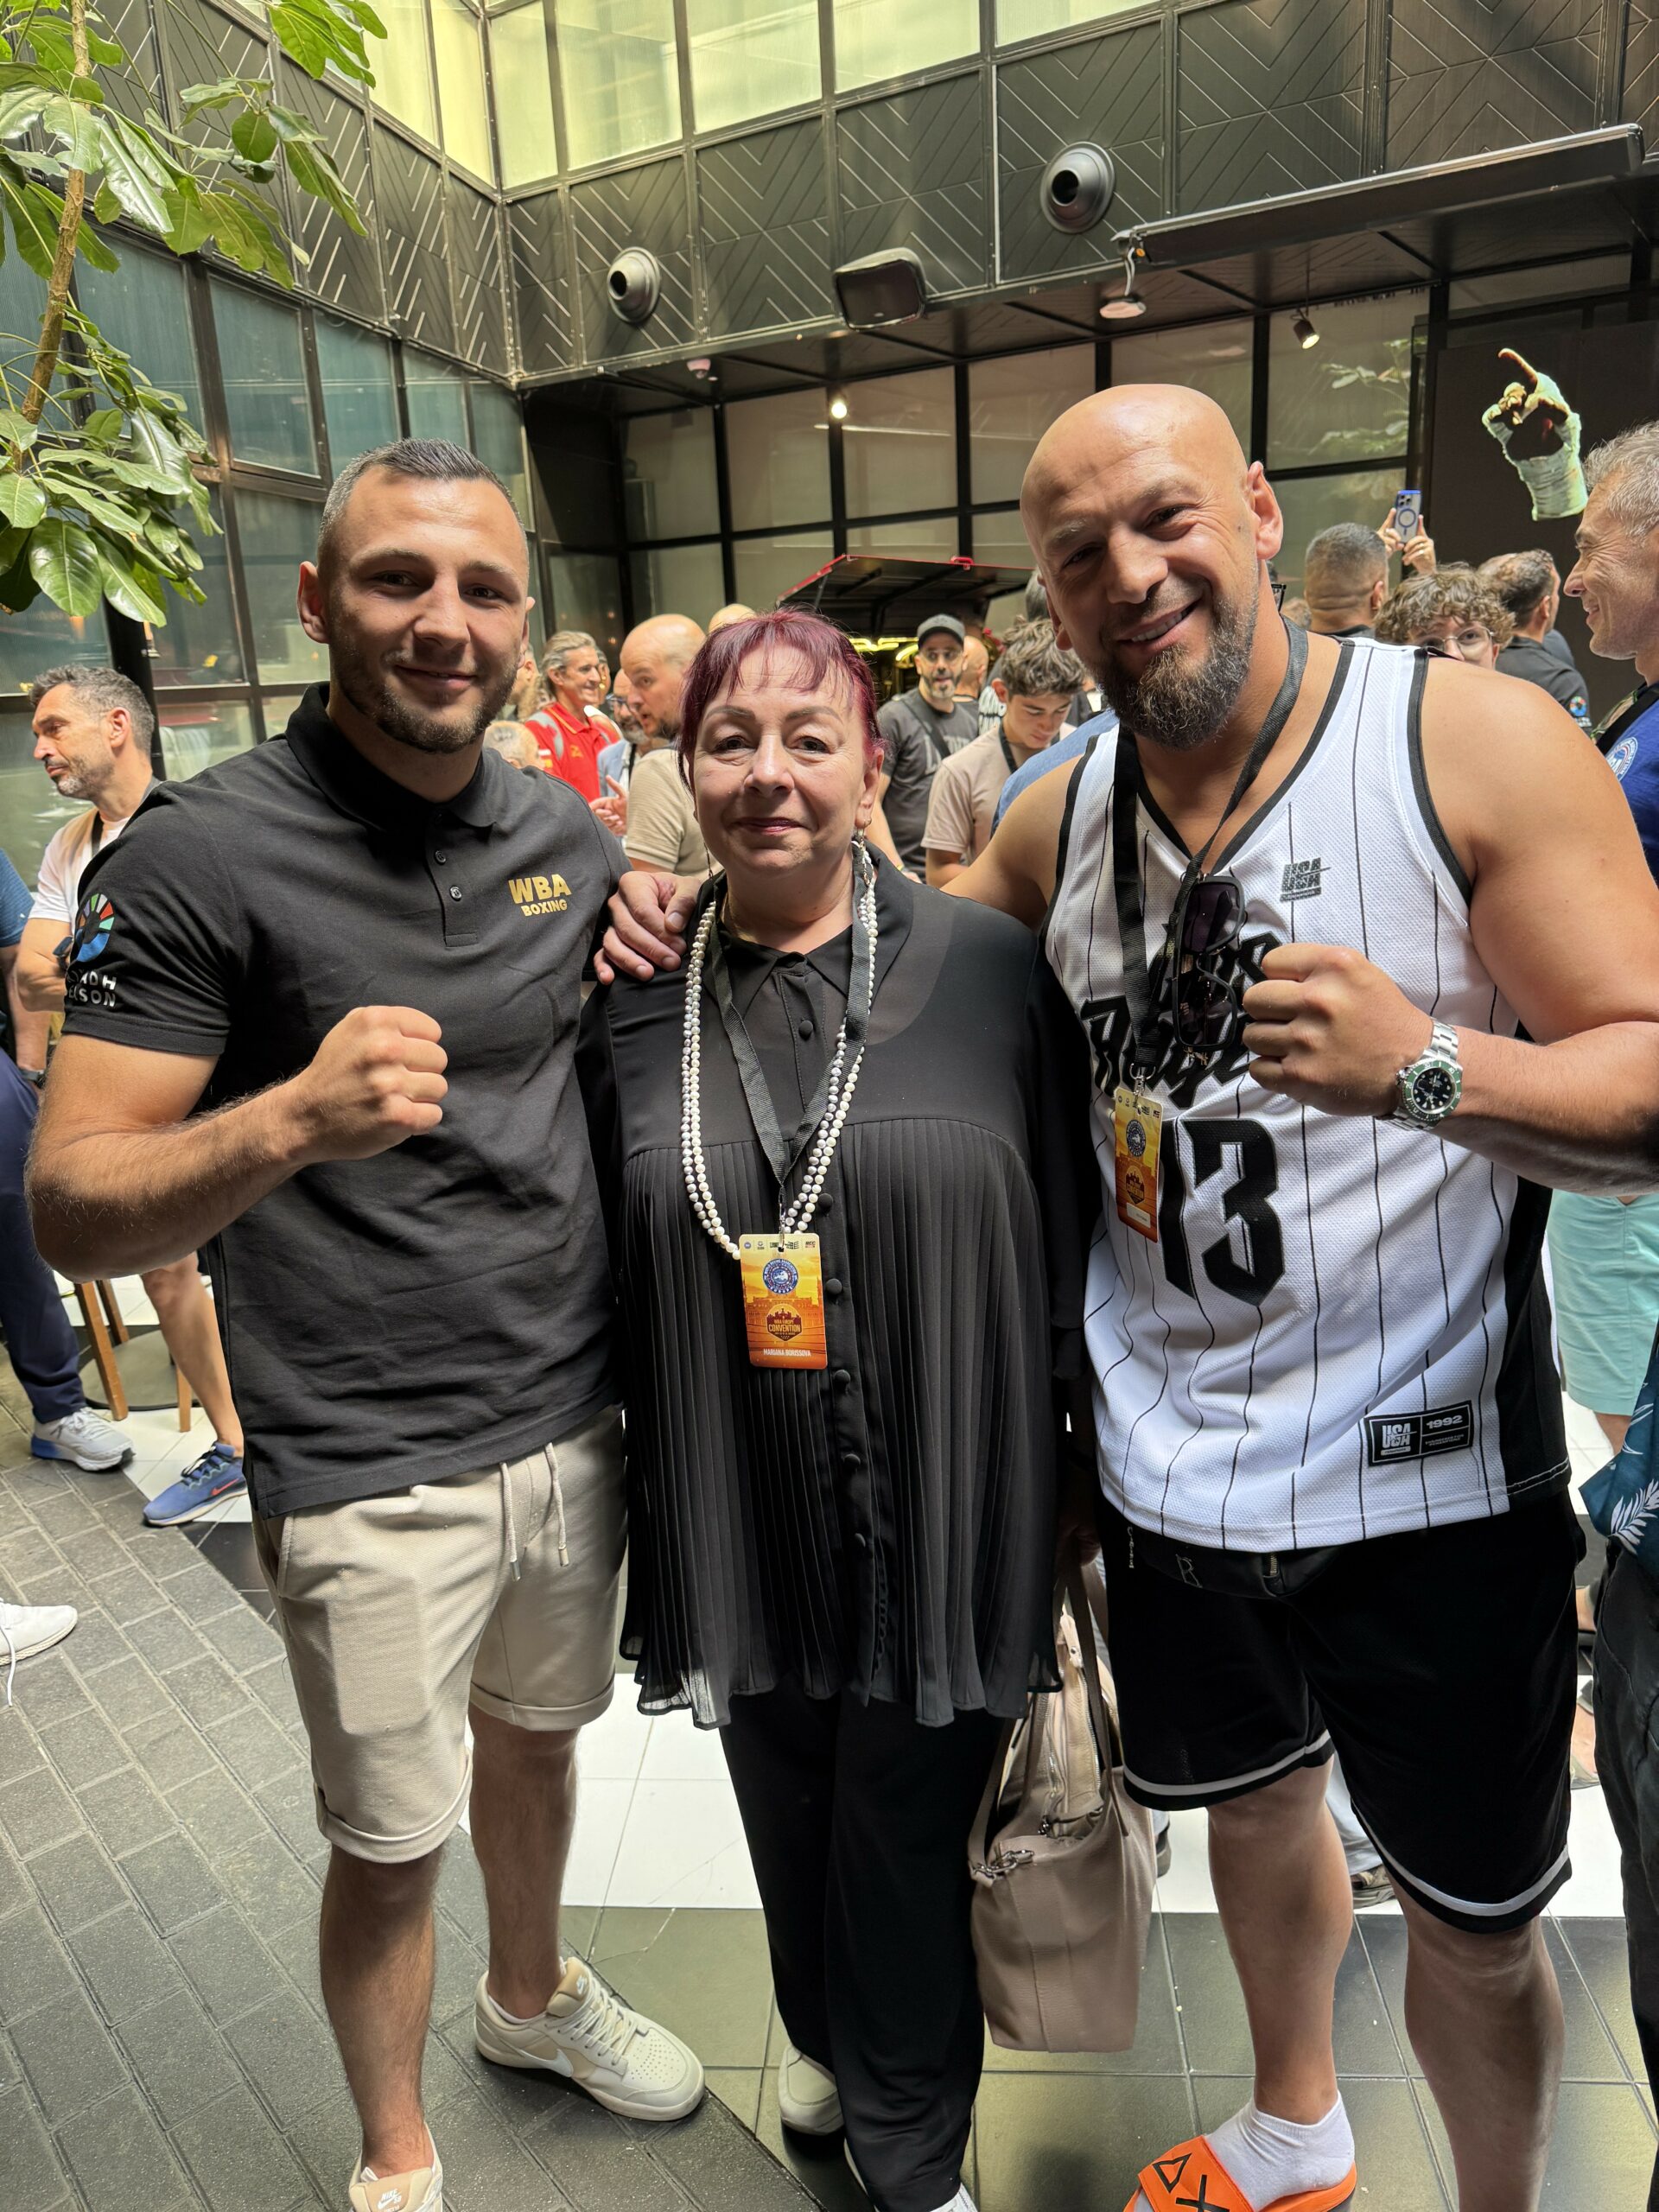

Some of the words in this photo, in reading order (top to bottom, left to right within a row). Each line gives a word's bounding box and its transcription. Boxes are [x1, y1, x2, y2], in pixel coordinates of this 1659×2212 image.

[508, 874, 572, 904] WBA
[521, 899, 568, 917] BOXING
[1159, 1118, 1286, 1306] 13
[768, 1324, 801, 1332] CONVENTION
[1426, 1414, 1464, 1429] 1992
[1382, 1422, 1412, 1448] USA
